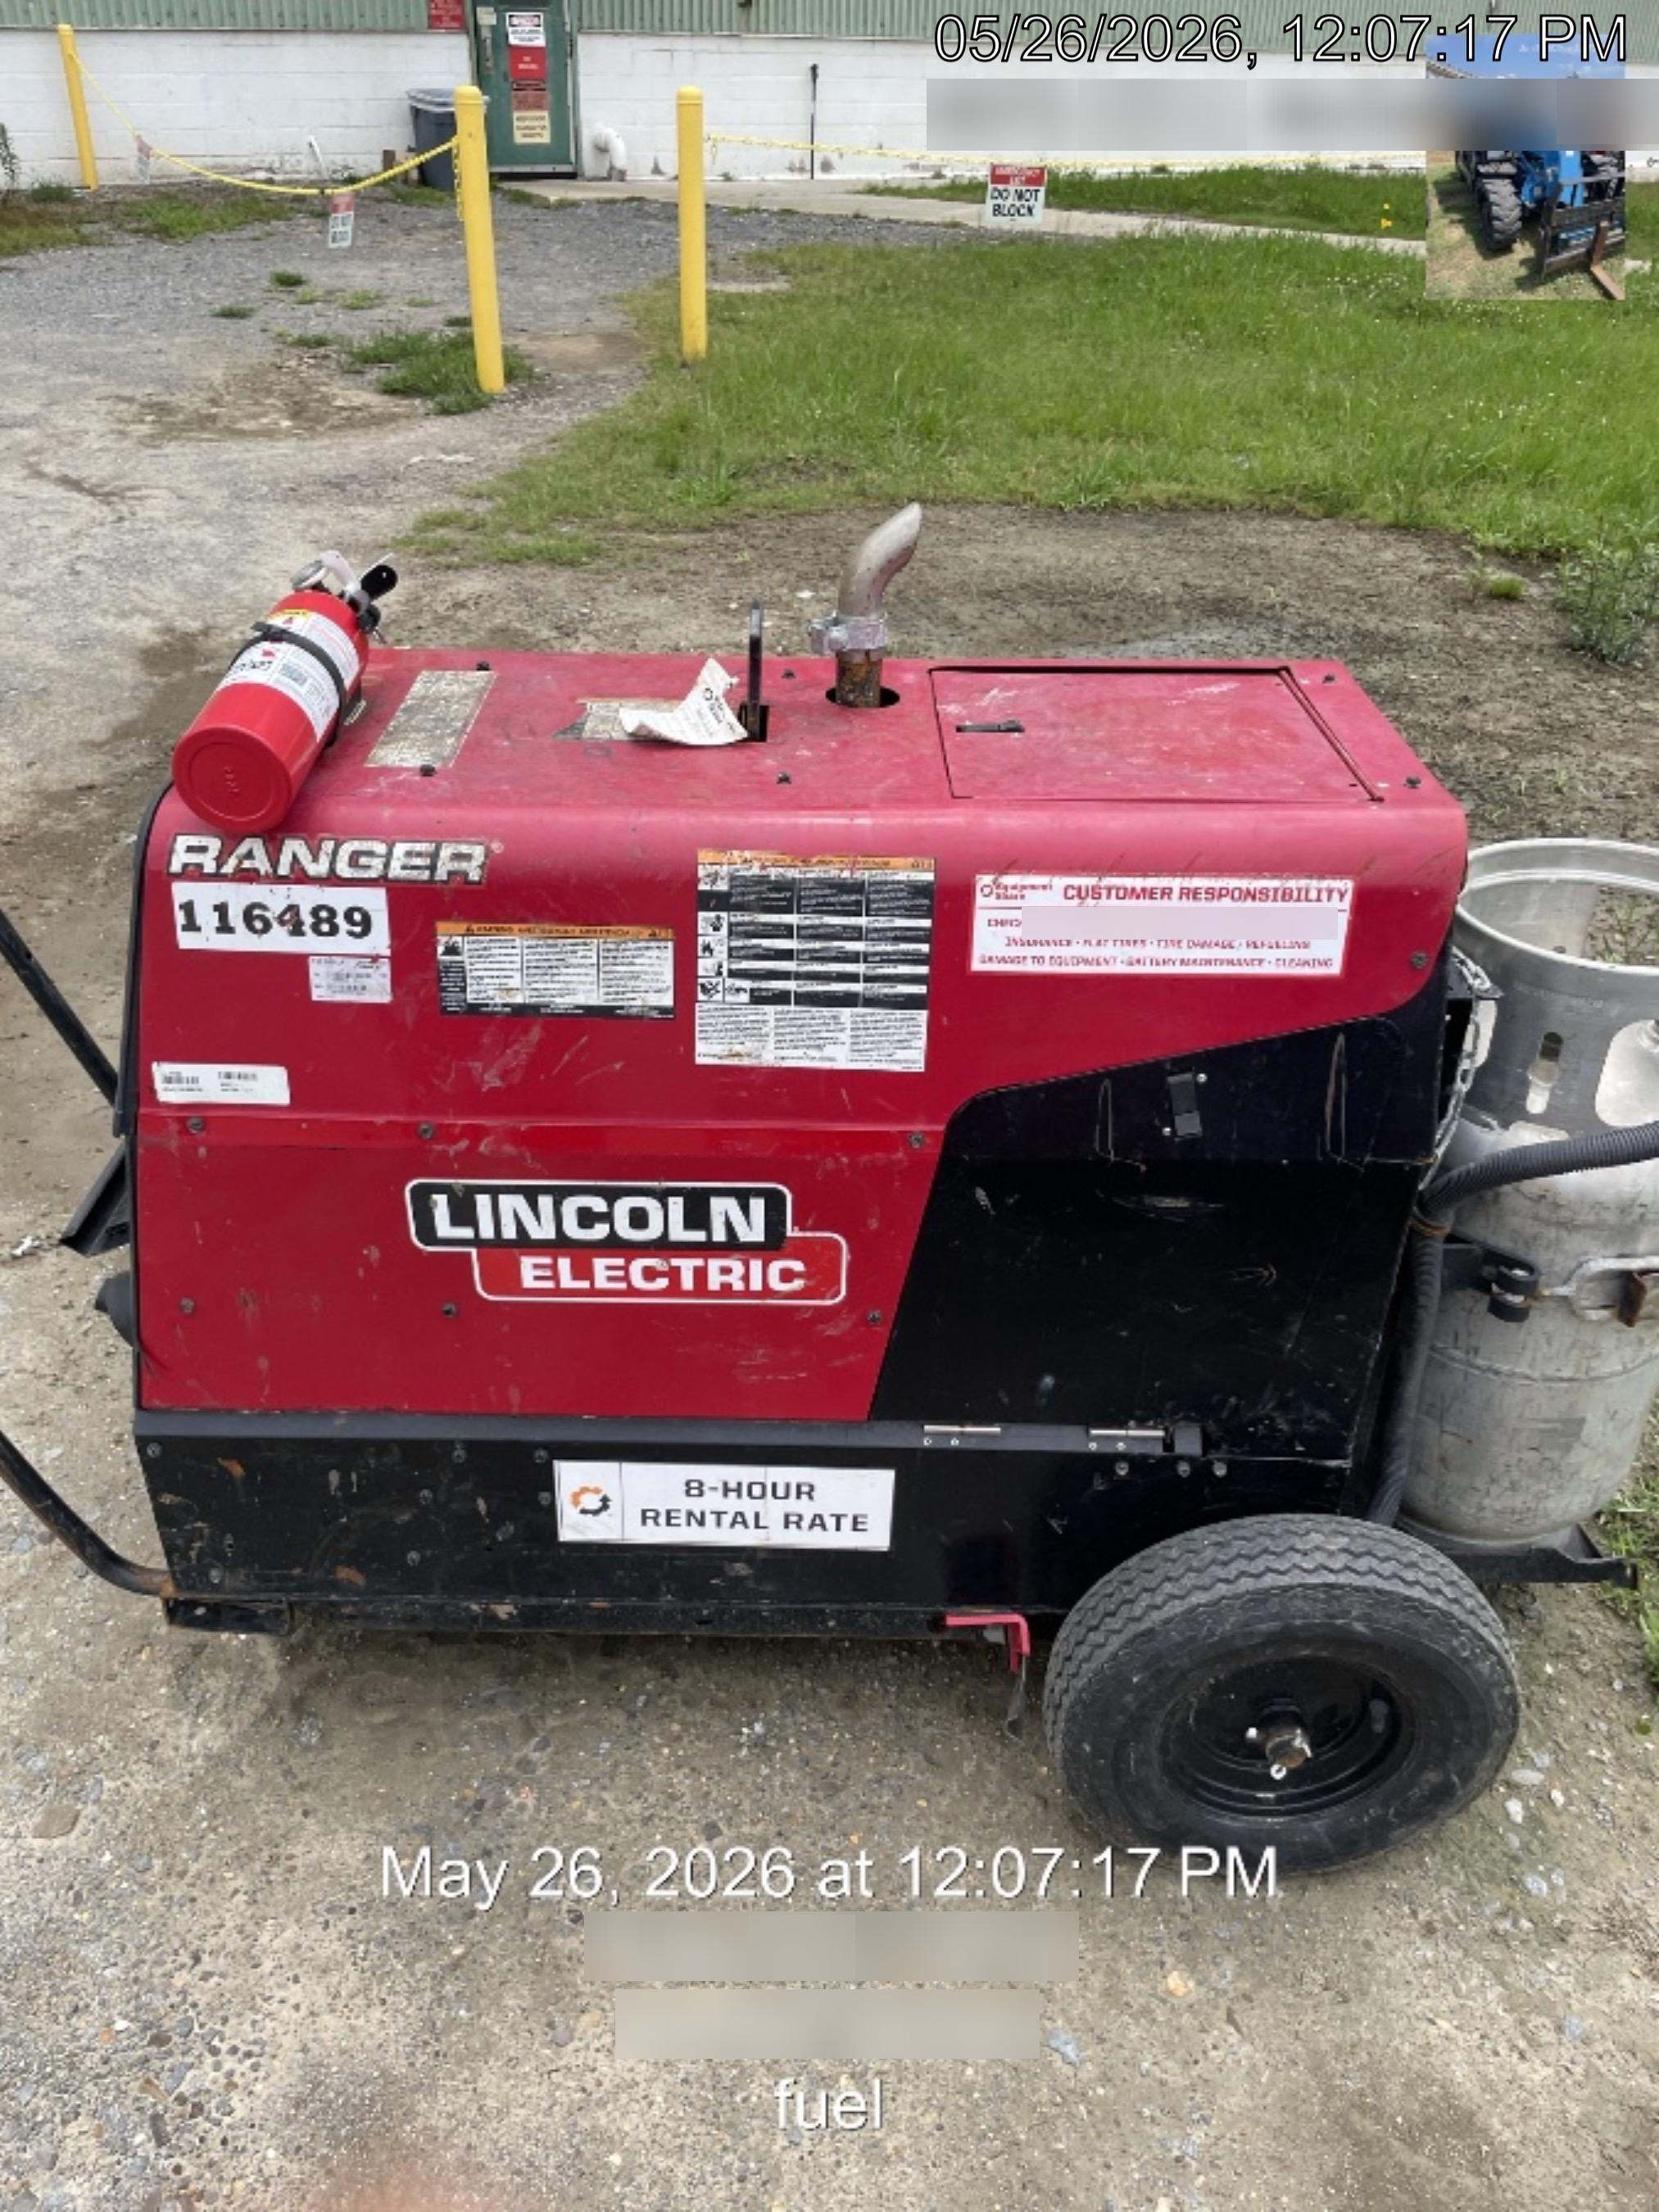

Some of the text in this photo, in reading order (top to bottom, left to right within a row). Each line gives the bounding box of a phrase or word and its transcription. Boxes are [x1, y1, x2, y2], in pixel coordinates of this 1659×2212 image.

[990, 187, 1040, 202] DO NOT
[992, 203, 1035, 217] BLOCK
[167, 834, 490, 884] RANGER
[1064, 884, 1349, 903] CUSTOMER RESPONSIBILITY
[179, 899, 373, 939] 116489
[1030, 955, 1045, 965] TO
[1049, 956, 1117, 967] EQUIPMENT
[431, 1193, 766, 1243] LINCOLN
[520, 1255, 807, 1292] ELECTRIC
[684, 1478, 815, 1502] 8-HOUR
[640, 1507, 869, 1533] RENTAL RATE
